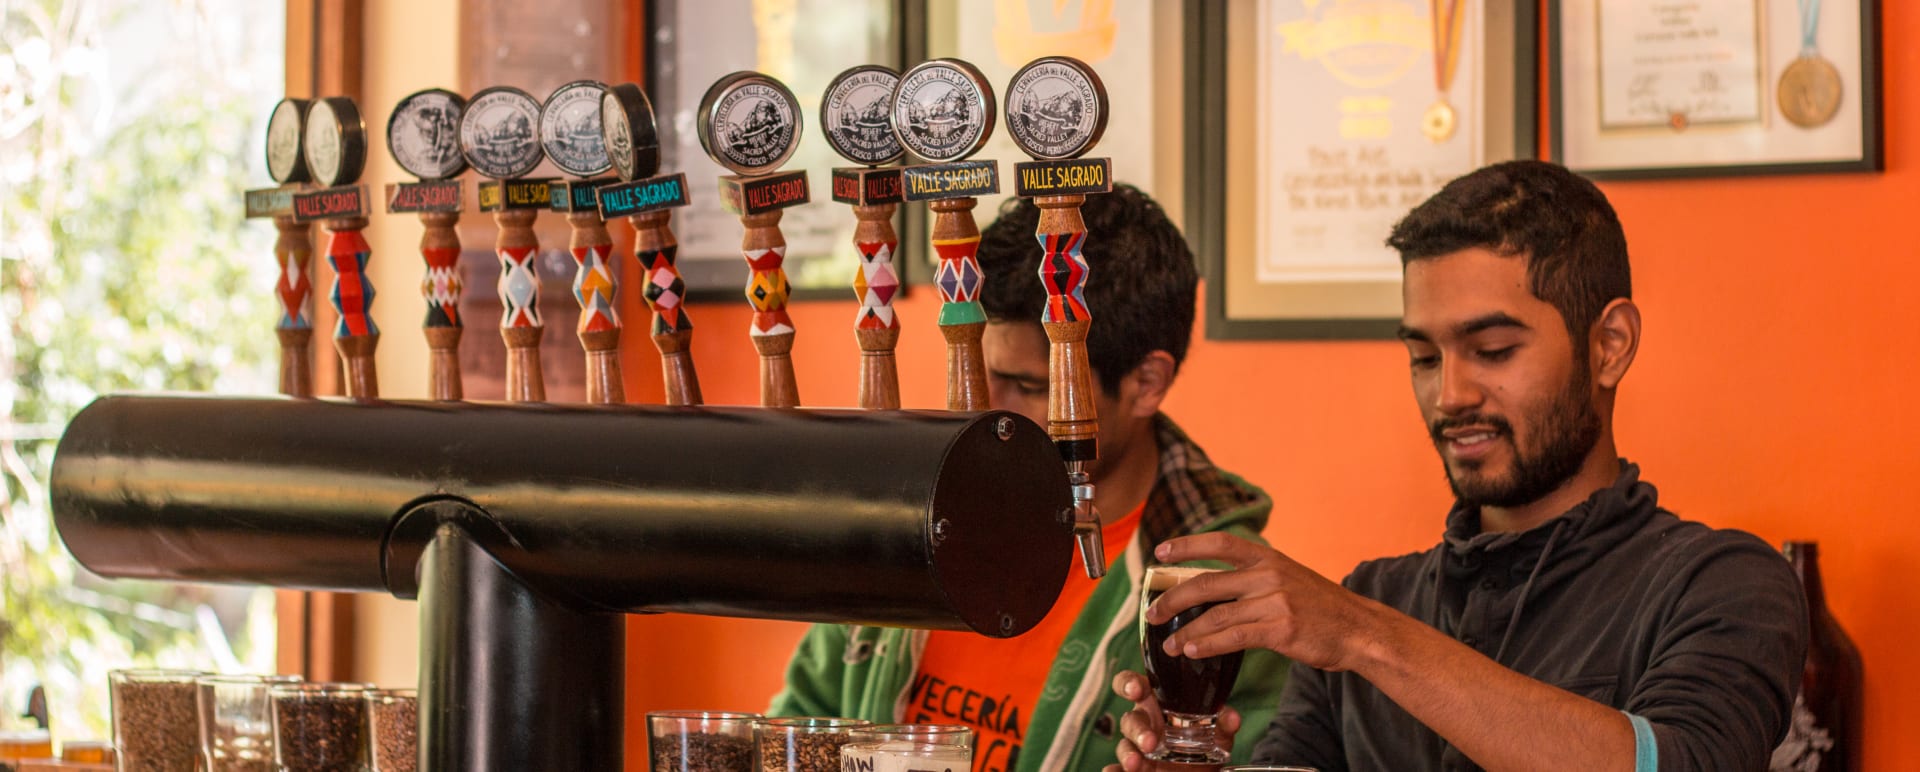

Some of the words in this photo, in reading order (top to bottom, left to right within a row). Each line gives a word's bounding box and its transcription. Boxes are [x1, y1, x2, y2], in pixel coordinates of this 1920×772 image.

[871, 74, 891, 87] VALLE
[1060, 66, 1080, 83] VALLE
[1076, 80, 1093, 114] SAGRADO
[761, 87, 786, 109] SAGRADO
[919, 132, 941, 146] SACRED
[942, 130, 961, 145] VALLEY
[1026, 123, 1047, 141] SACRED
[1047, 132, 1068, 143] VALLEY
[867, 177, 888, 200] VALLE
[910, 171, 941, 194] VALLE
[944, 167, 991, 191] SAGRADO
[1022, 167, 1053, 190] VALLE
[1056, 165, 1104, 188] SAGRADO
[297, 195, 321, 216] VALLE
[322, 192, 357, 214] SAGRADO
[420, 186, 457, 208] SAGRADO
[508, 184, 529, 204] VALLE
[603, 188, 634, 213] VALLE
[635, 180, 680, 207] SAGRADO
[748, 185, 771, 209] VALLE
[771, 178, 804, 204] SAGRADO
